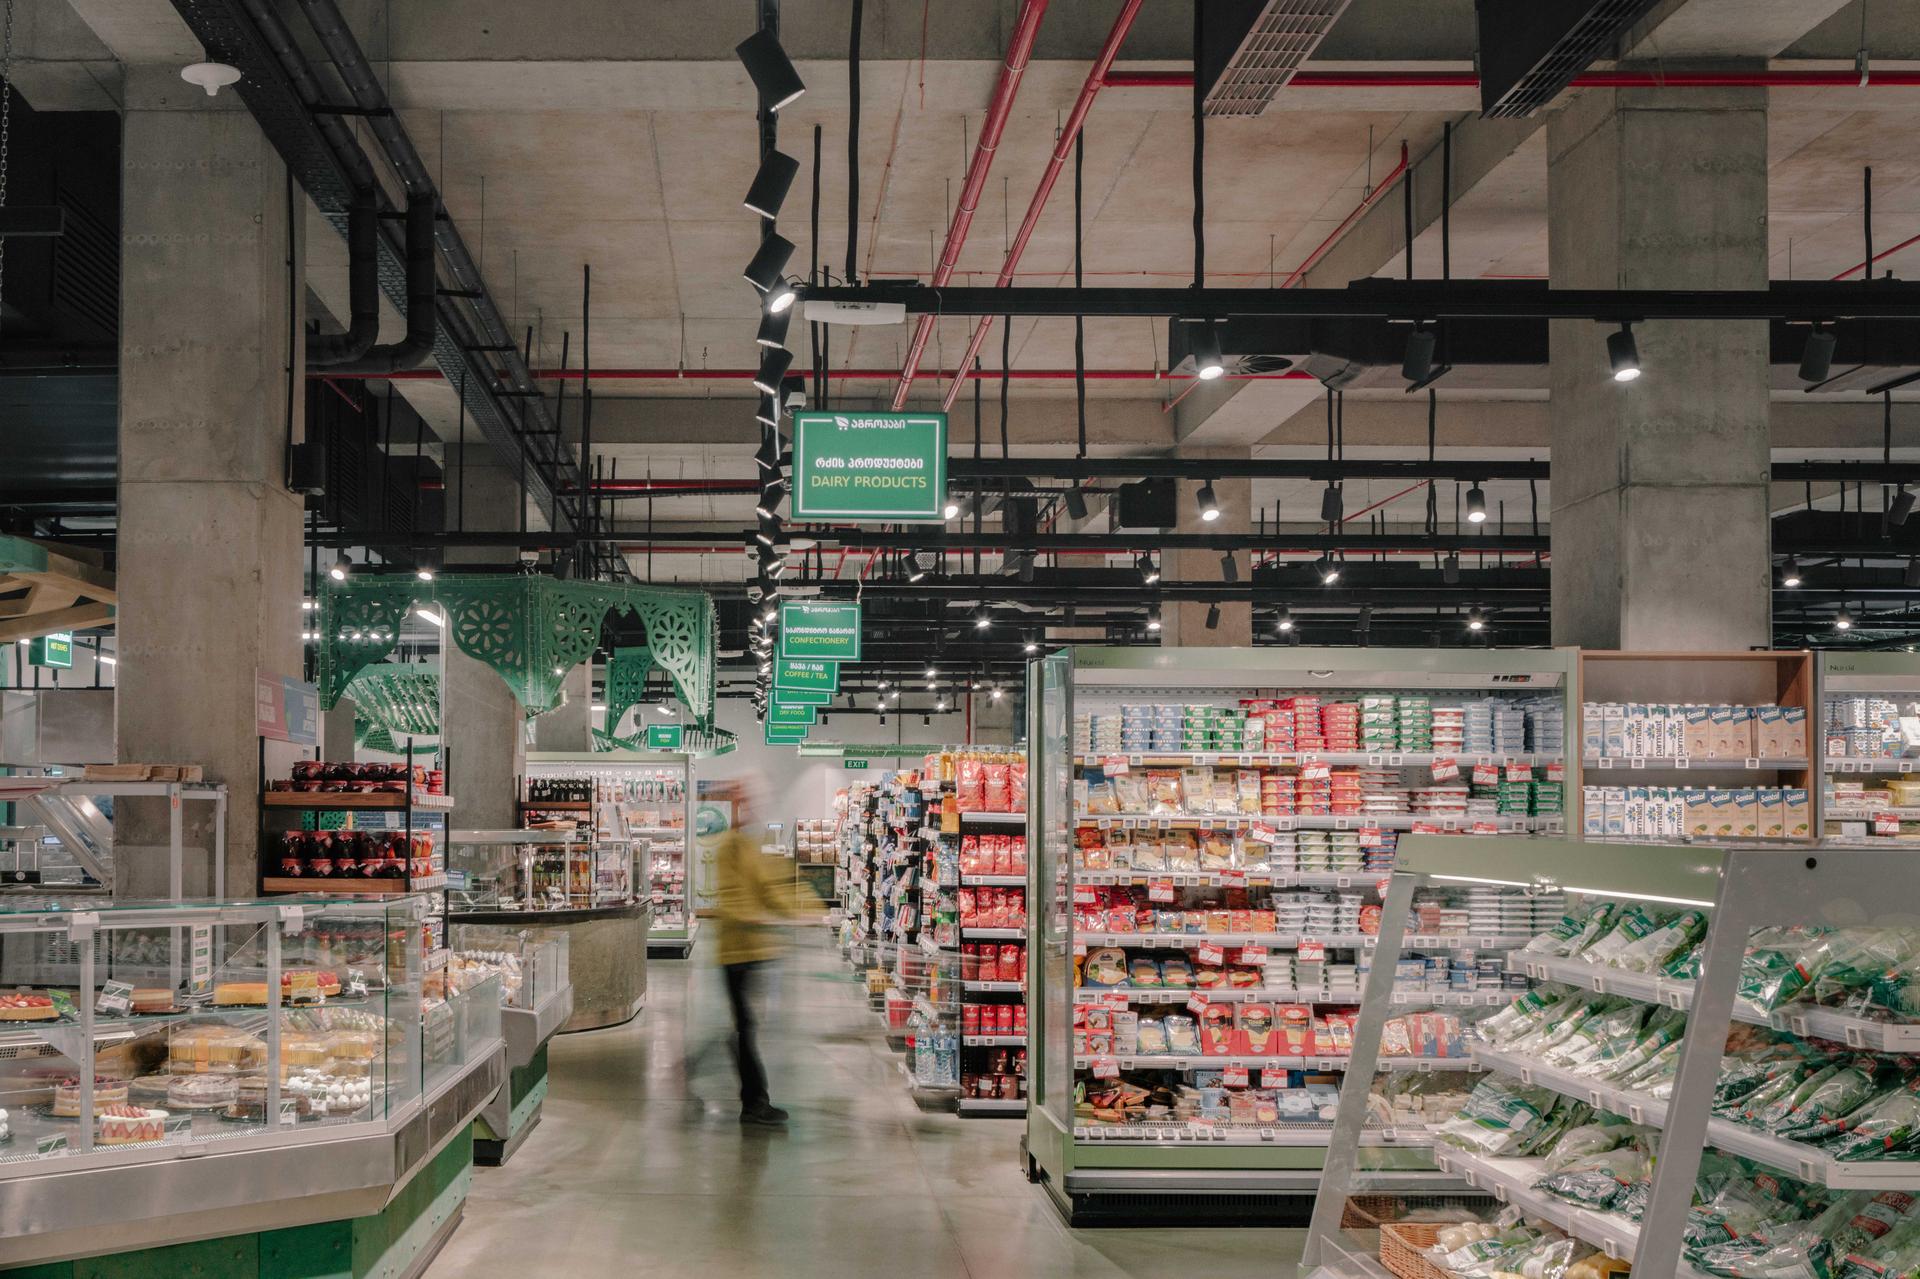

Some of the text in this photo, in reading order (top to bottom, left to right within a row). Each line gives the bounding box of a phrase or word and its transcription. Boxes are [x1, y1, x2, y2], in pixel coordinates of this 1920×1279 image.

[851, 419, 906, 430] აგროჰაბი
[815, 457, 924, 469] რძის პროდუქტები
[811, 476, 927, 488] DAIRY PRODUCTS
[1687, 708, 1706, 719] Santal
[1711, 708, 1730, 719] Santal
[1761, 707, 1780, 719] Santal
[1784, 709, 1804, 719] Santal
[1655, 720, 1663, 757] parmalat
[1676, 720, 1684, 756] parmalat
[847, 760, 865, 768] EXIT
[1687, 791, 1706, 803] Santal
[1710, 792, 1730, 803] Santal
[1735, 792, 1755, 803] Santal
[1761, 791, 1780, 803] Santal
[1786, 792, 1805, 802] Santal
